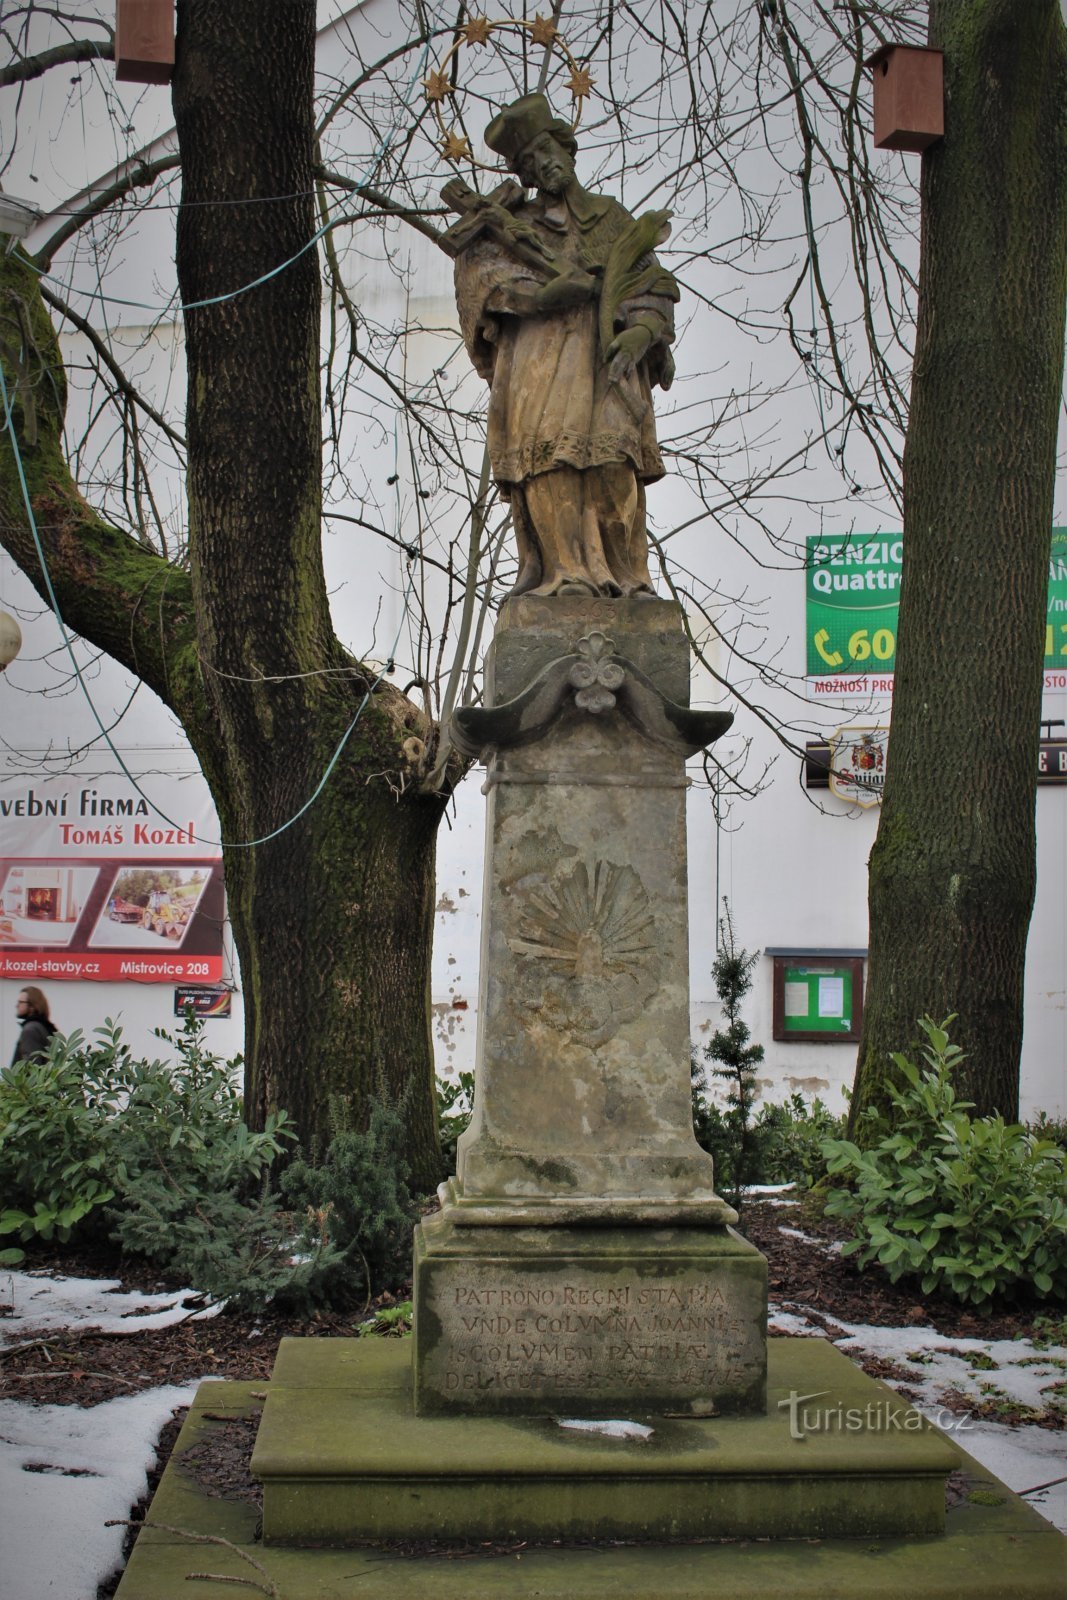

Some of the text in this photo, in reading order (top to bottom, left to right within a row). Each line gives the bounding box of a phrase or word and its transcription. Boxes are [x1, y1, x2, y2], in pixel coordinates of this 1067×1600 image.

[813, 569, 902, 594] Quattr
[848, 628, 895, 661] 60
[814, 678, 869, 693] MOŽNOST
[134, 822, 196, 845] Kozel
[120, 962, 183, 975] Mistrovice
[187, 963, 209, 976] 208
[455, 1287, 554, 1306] PATRONO
